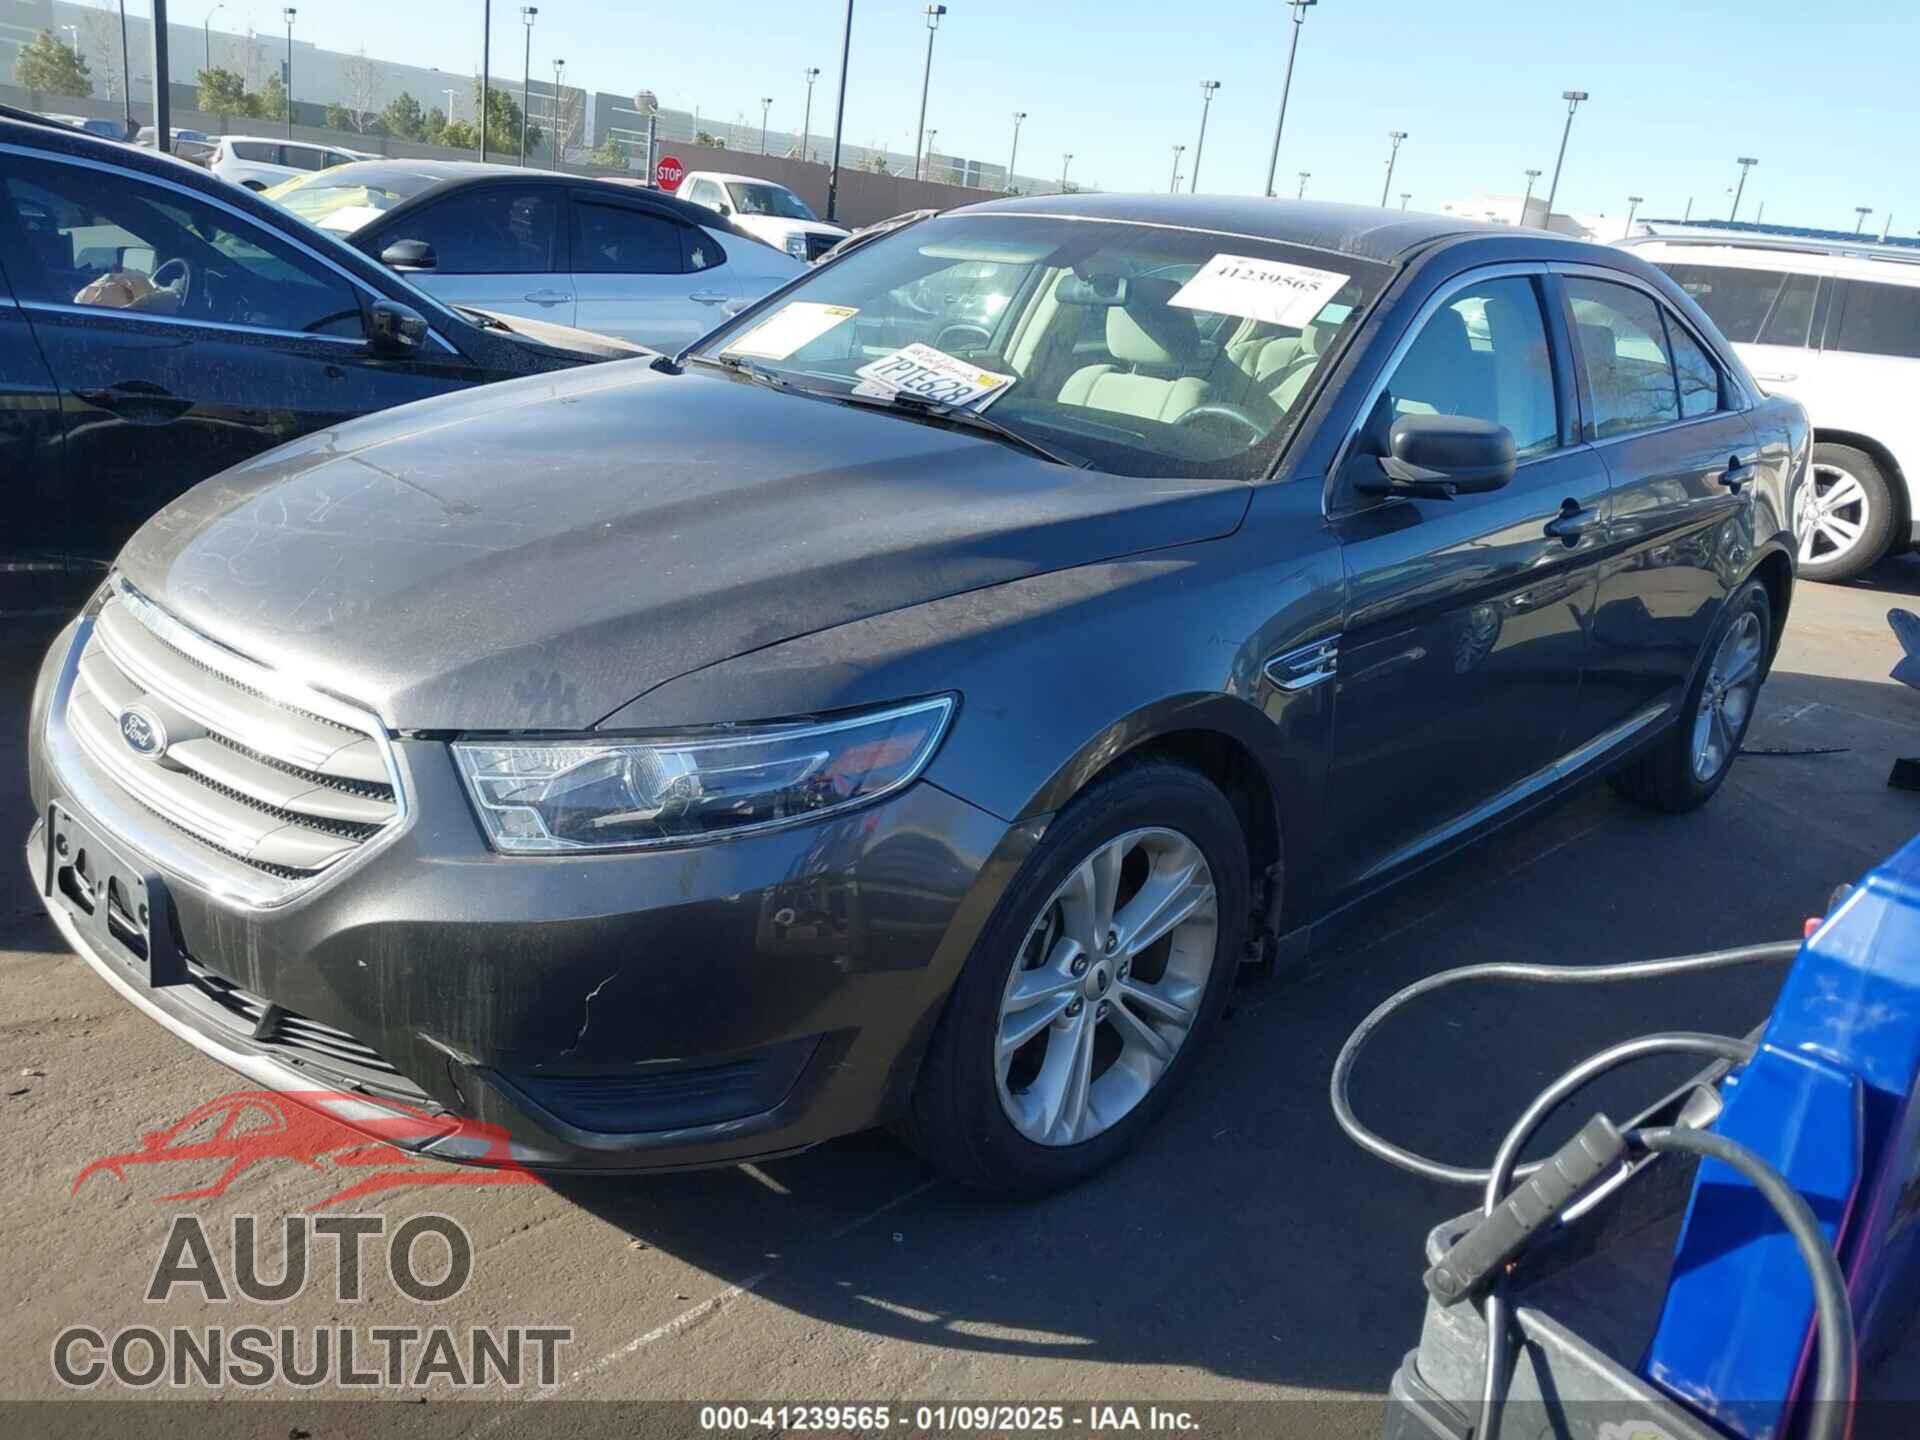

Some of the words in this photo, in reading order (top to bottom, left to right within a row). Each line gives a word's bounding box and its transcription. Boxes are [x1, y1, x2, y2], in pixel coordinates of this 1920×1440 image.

[657, 166, 682, 181] STOP
[873, 355, 973, 403] 7PTE628
[124, 714, 151, 747] Ford
